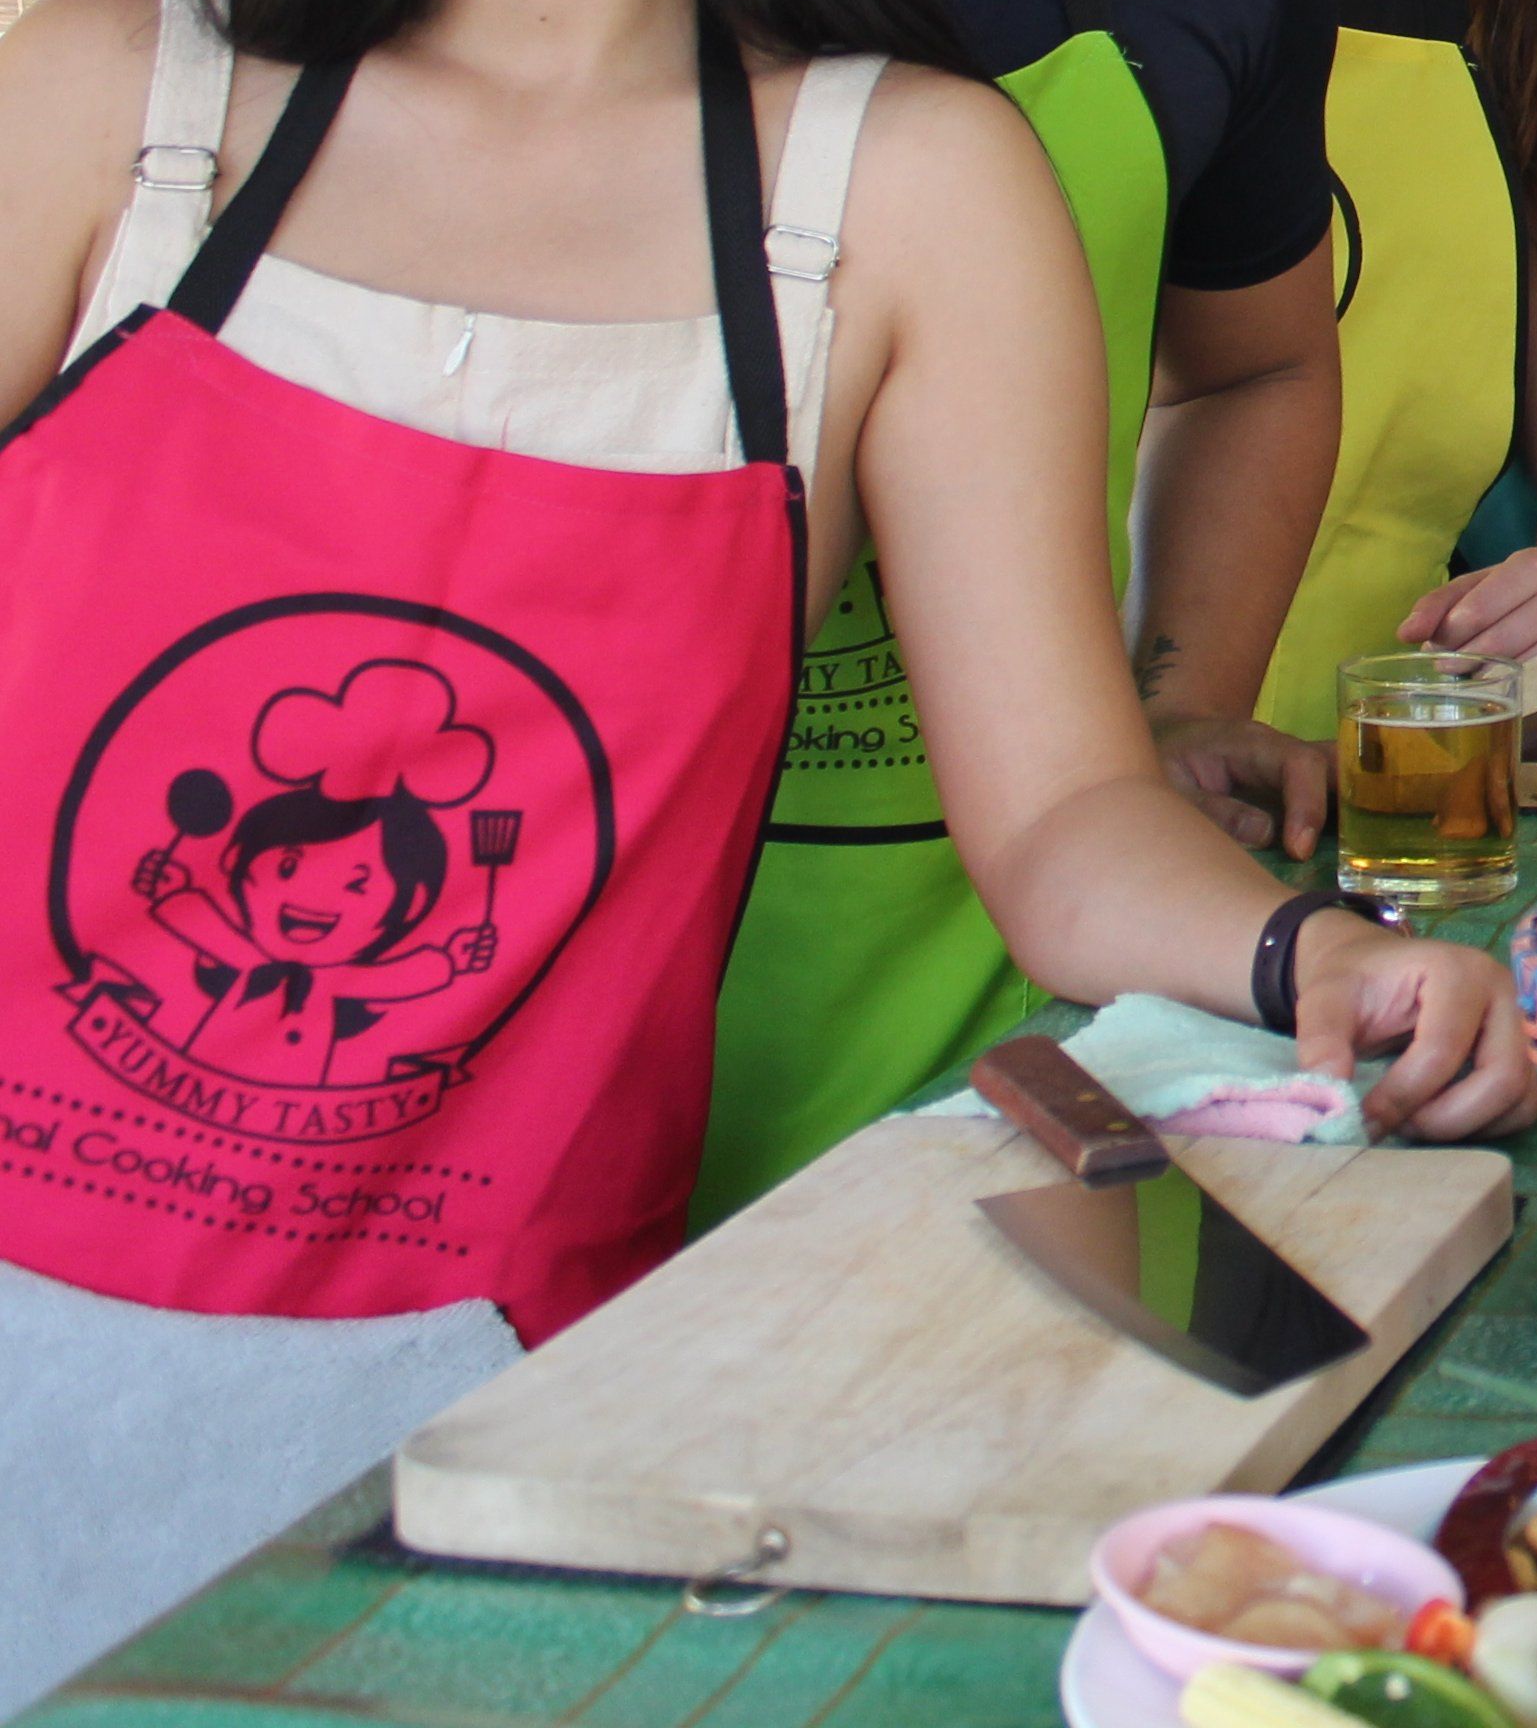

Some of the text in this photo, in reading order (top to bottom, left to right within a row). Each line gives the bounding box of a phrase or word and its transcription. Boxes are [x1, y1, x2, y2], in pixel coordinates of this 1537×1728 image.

[786, 724, 886, 753] oking
[101, 1016, 415, 1137] YUMMY TASTY
[72, 1130, 273, 1216] Cooking
[289, 1181, 447, 1225] School
